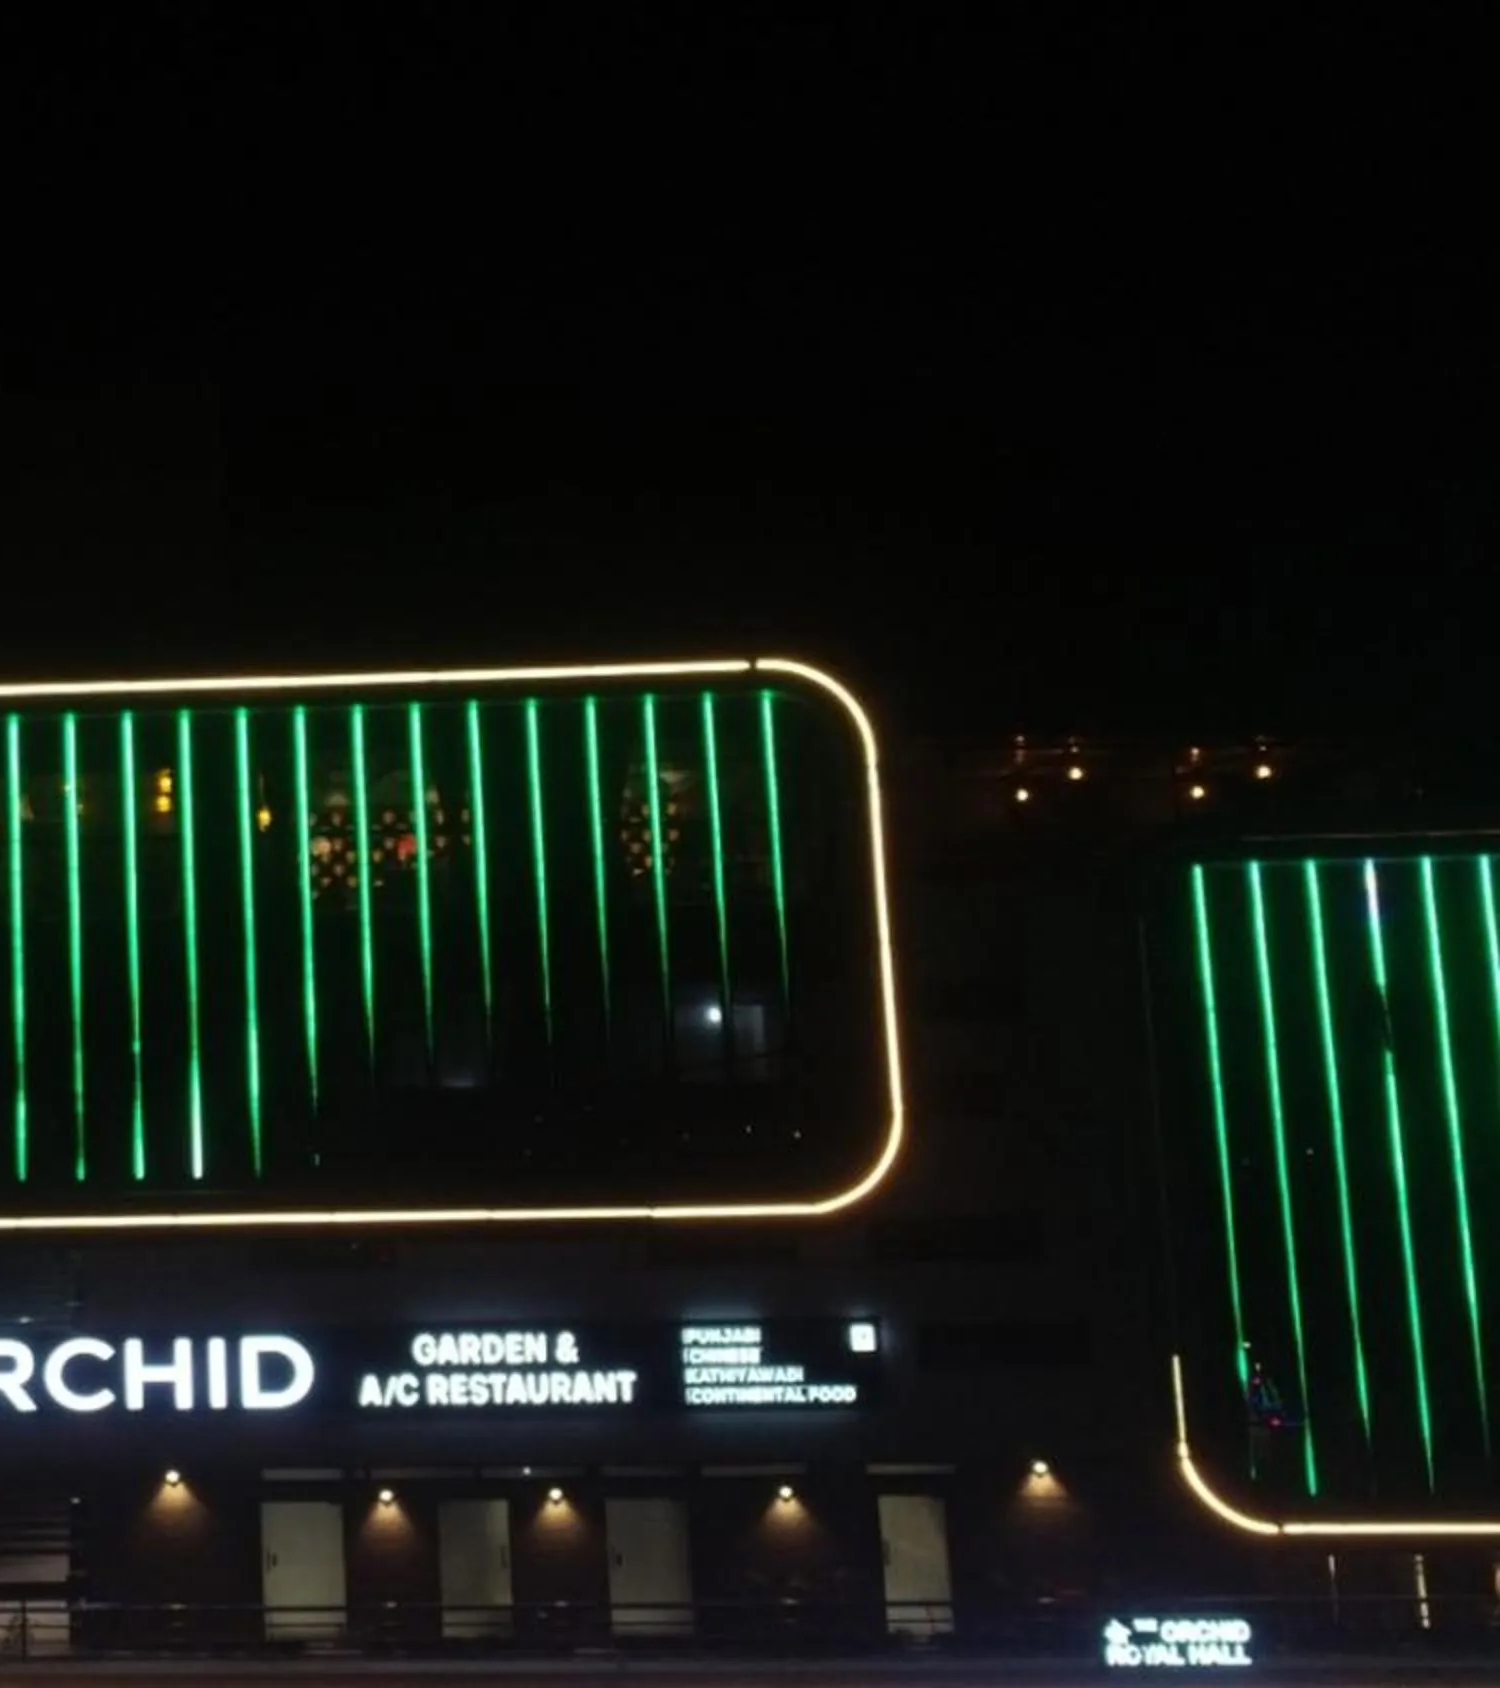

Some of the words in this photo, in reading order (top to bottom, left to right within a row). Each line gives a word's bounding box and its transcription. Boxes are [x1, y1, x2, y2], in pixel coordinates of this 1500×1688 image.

[411, 1332, 548, 1366] GARDEN
[555, 1331, 580, 1364] &
[358, 1373, 420, 1407] A/C
[426, 1369, 637, 1406] RESTAURANT
[809, 1385, 857, 1403] FOOD
[1187, 1642, 1253, 1667] HALL
